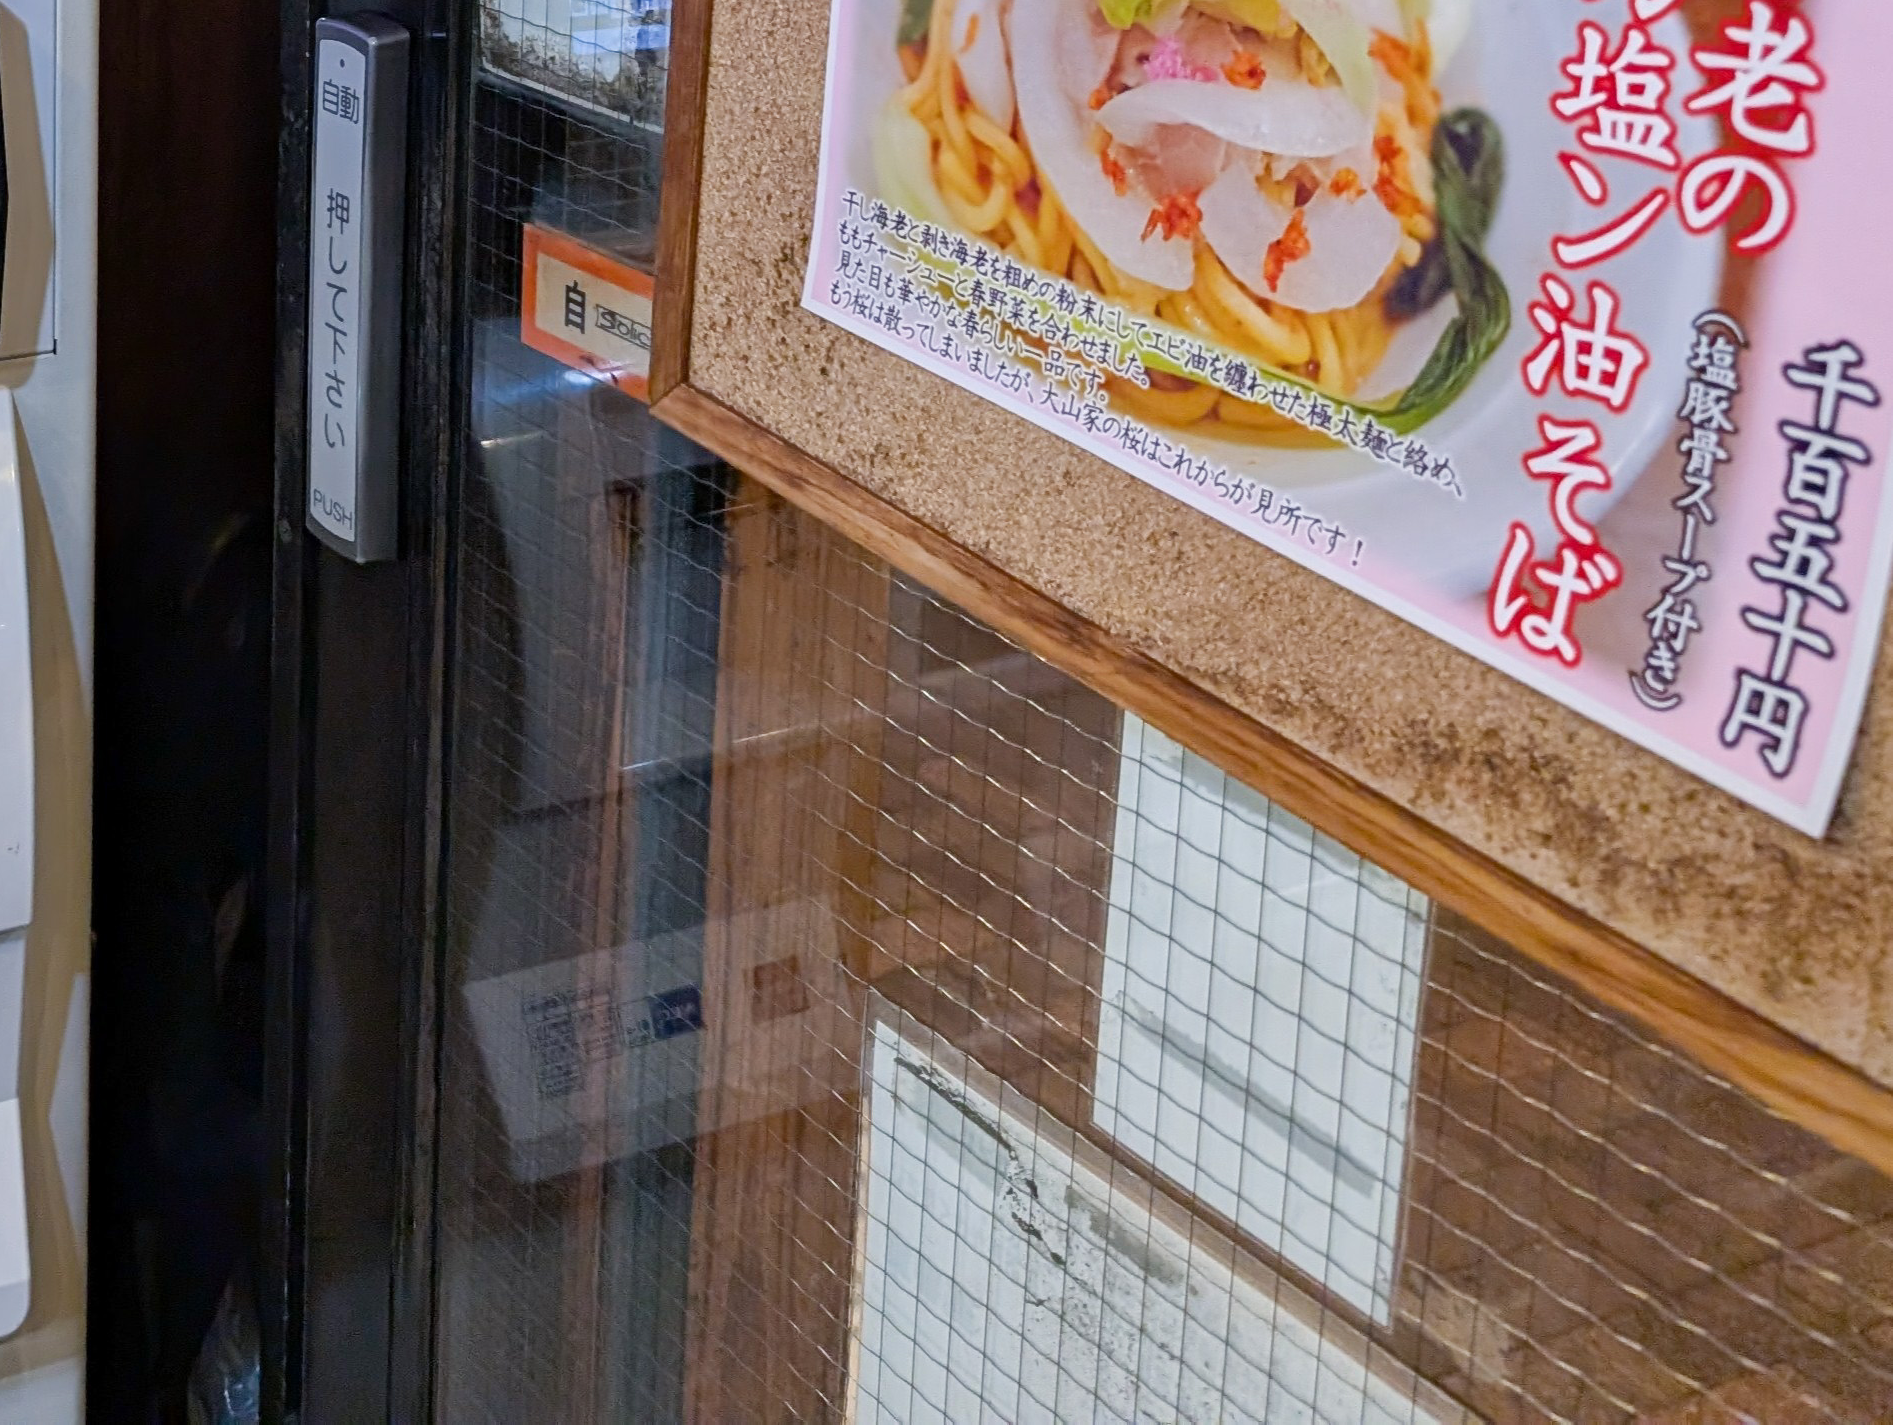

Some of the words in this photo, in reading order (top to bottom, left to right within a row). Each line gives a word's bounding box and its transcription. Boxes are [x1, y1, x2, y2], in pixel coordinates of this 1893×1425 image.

[322, 78, 360, 125] 自動
[323, 188, 350, 449] 押して下さい
[312, 488, 353, 531] PUSH
[1630, 309, 1750, 712] (塩豚骨スープ付き)
[1720, 339, 1881, 778] 千百五十円
